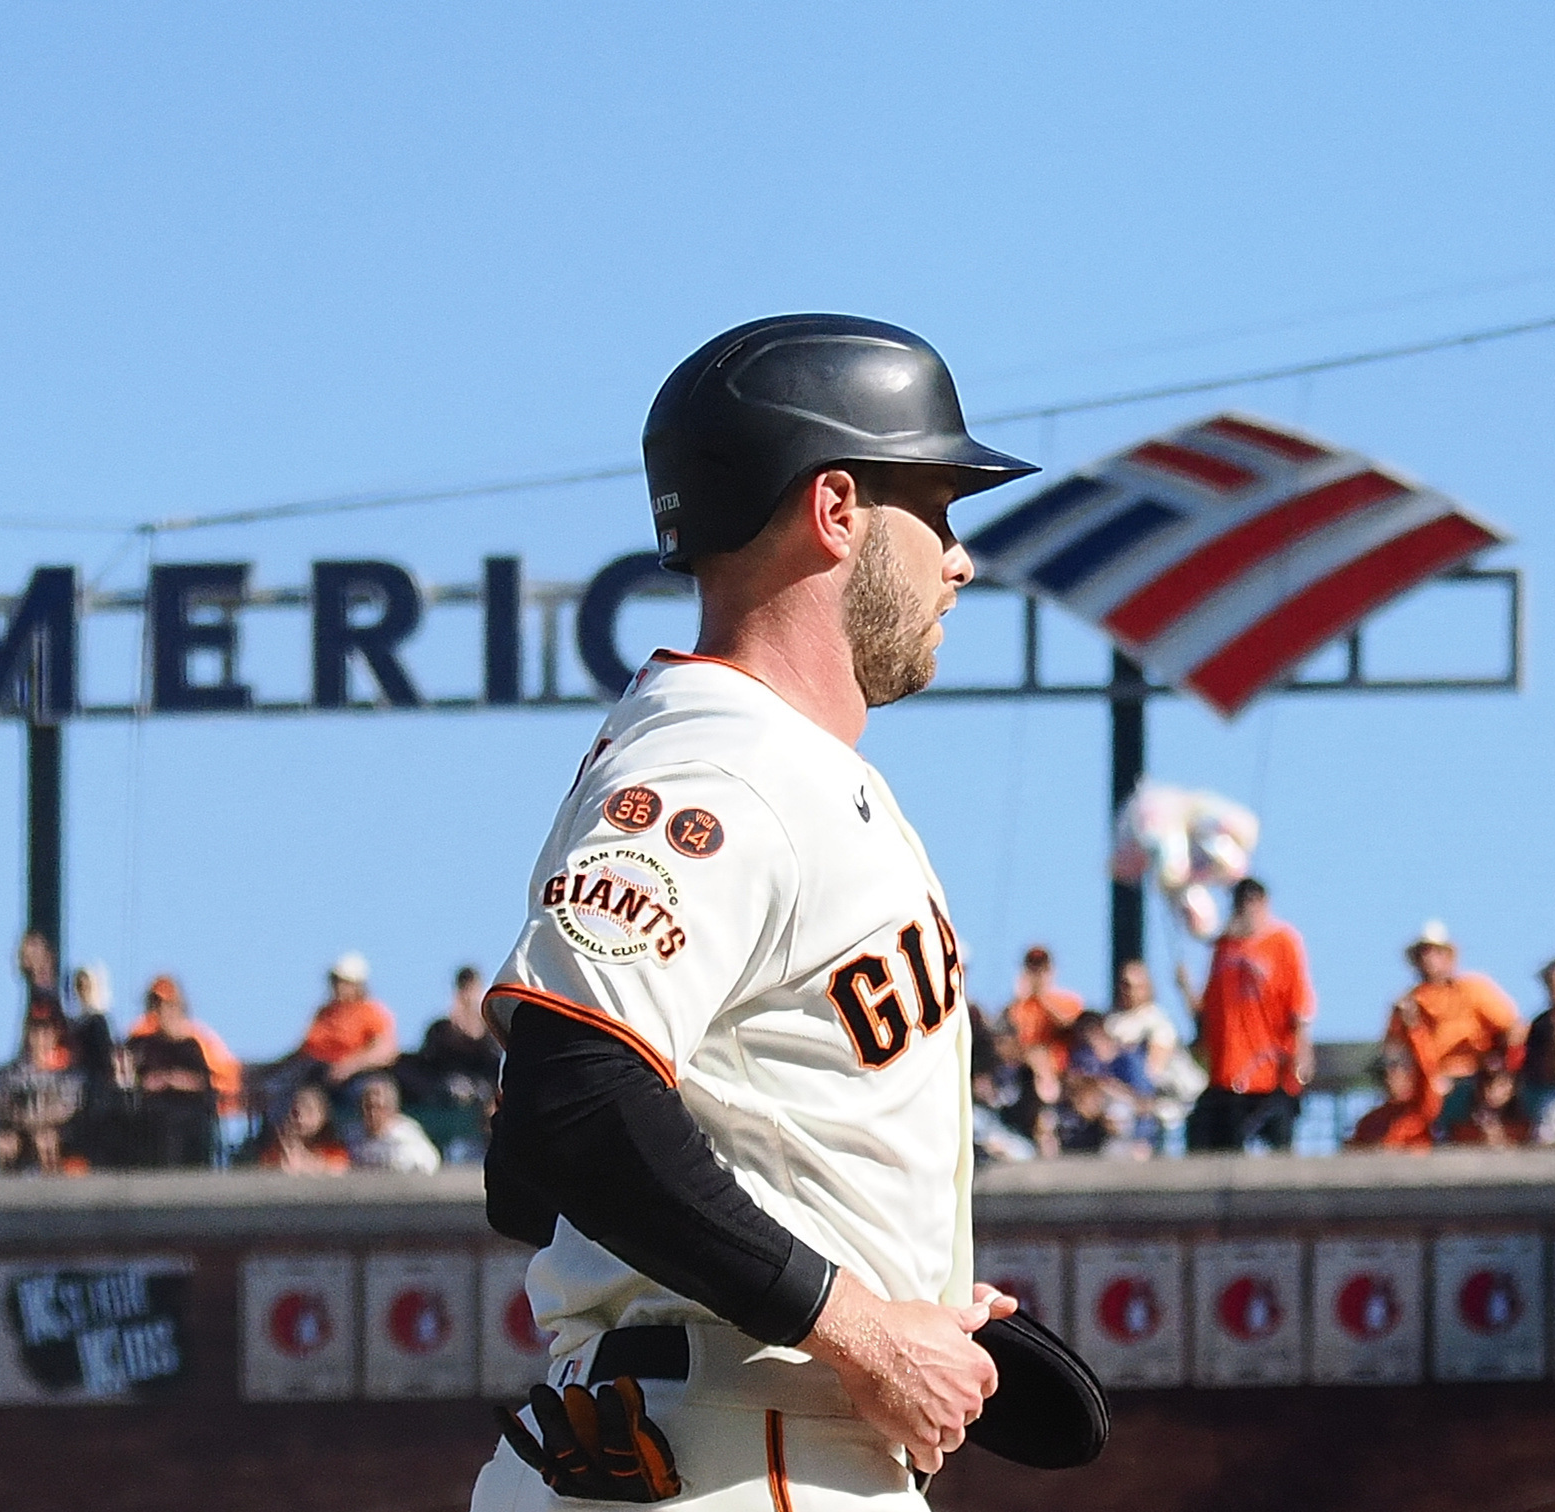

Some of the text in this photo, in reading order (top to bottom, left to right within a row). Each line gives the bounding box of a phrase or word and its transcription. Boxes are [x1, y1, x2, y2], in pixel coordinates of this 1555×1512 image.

[614, 800, 652, 824] 36
[680, 820, 711, 852] 14
[578, 850, 680, 907] SAN FRANCISCO
[541, 872, 687, 961] GIANTS
[556, 907, 649, 957] BASEBALL CLUB
